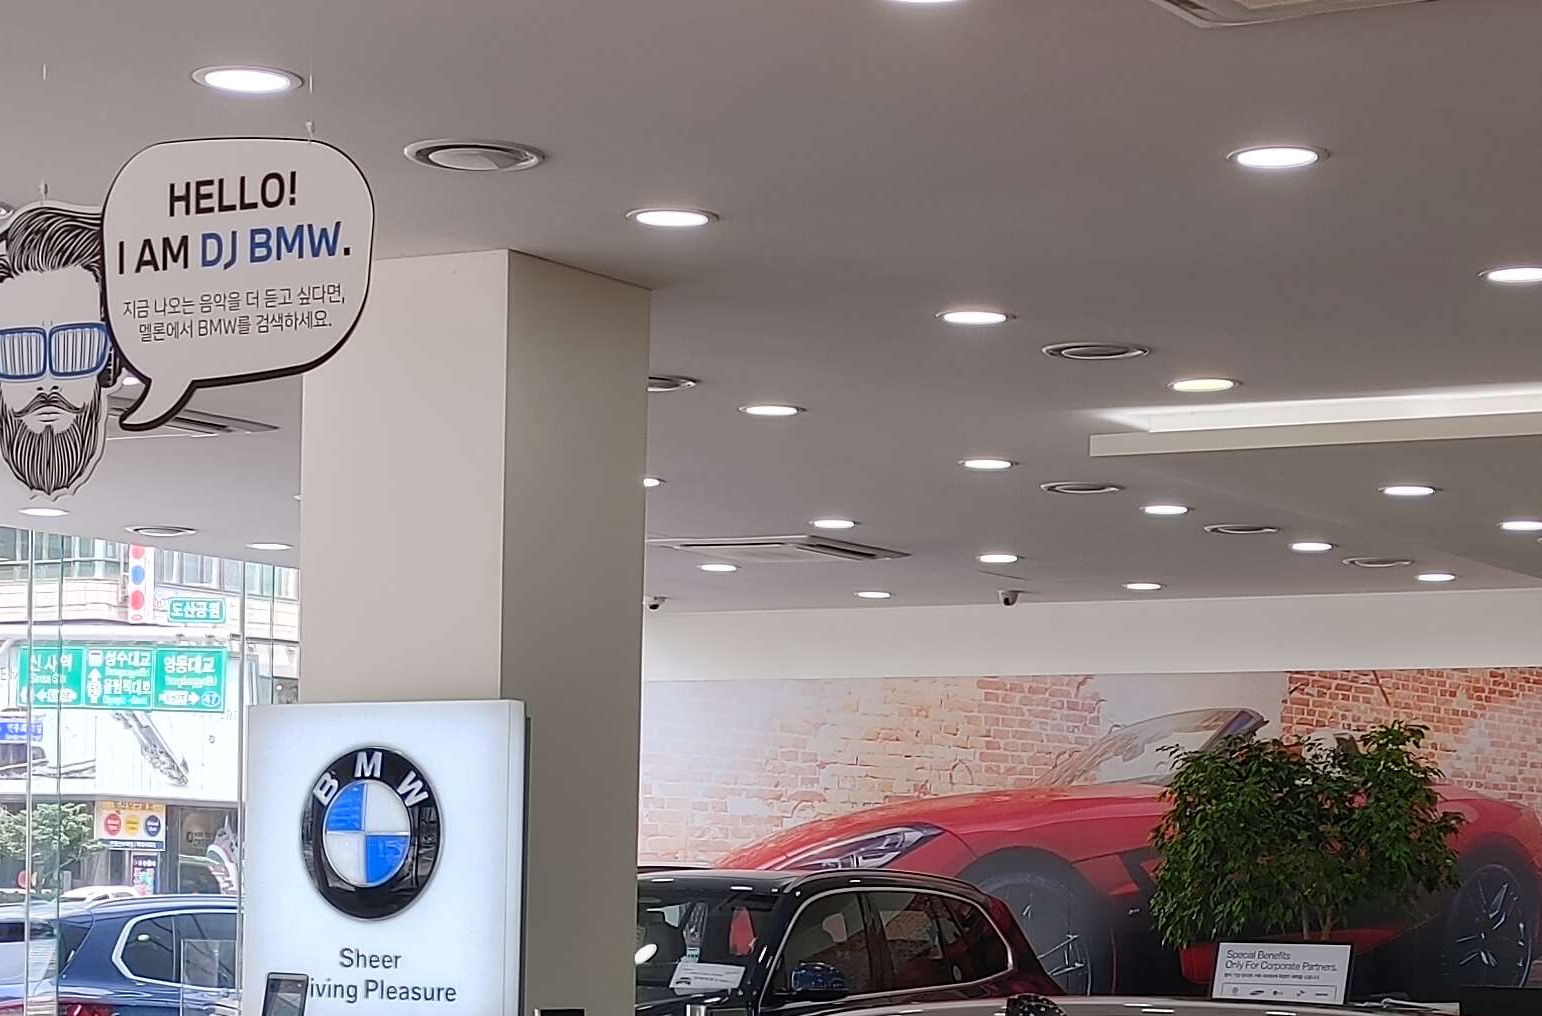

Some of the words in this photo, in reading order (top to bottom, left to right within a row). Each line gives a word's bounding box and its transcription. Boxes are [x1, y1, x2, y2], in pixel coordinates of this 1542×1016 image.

[168, 171, 297, 217] HELLO!
[117, 240, 125, 275] I
[134, 235, 189, 273] AM
[201, 231, 238, 270] DJ
[249, 222, 351, 264] BMW.
[122, 300, 150, 319] 지금
[154, 297, 195, 316] 나오는
[199, 292, 241, 313] 음악을
[246, 291, 260, 309] 더
[263, 287, 292, 308] 듣고
[139, 322, 194, 343] 멜론에서
[198, 316, 251, 337] BMW를
[256, 310, 332, 334] 검색하세요.
[312, 750, 429, 808] BMW
[339, 947, 402, 969] Sheer
[1225, 961, 1244, 971] Only
[1245, 961, 1260, 970] For
[1260, 962, 1301, 971] Corporate
[1226, 950, 1256, 960] Special
[1257, 950, 1291, 960] Benefits
[309, 978, 358, 1004] iving
[364, 979, 458, 1002] Pleasure
